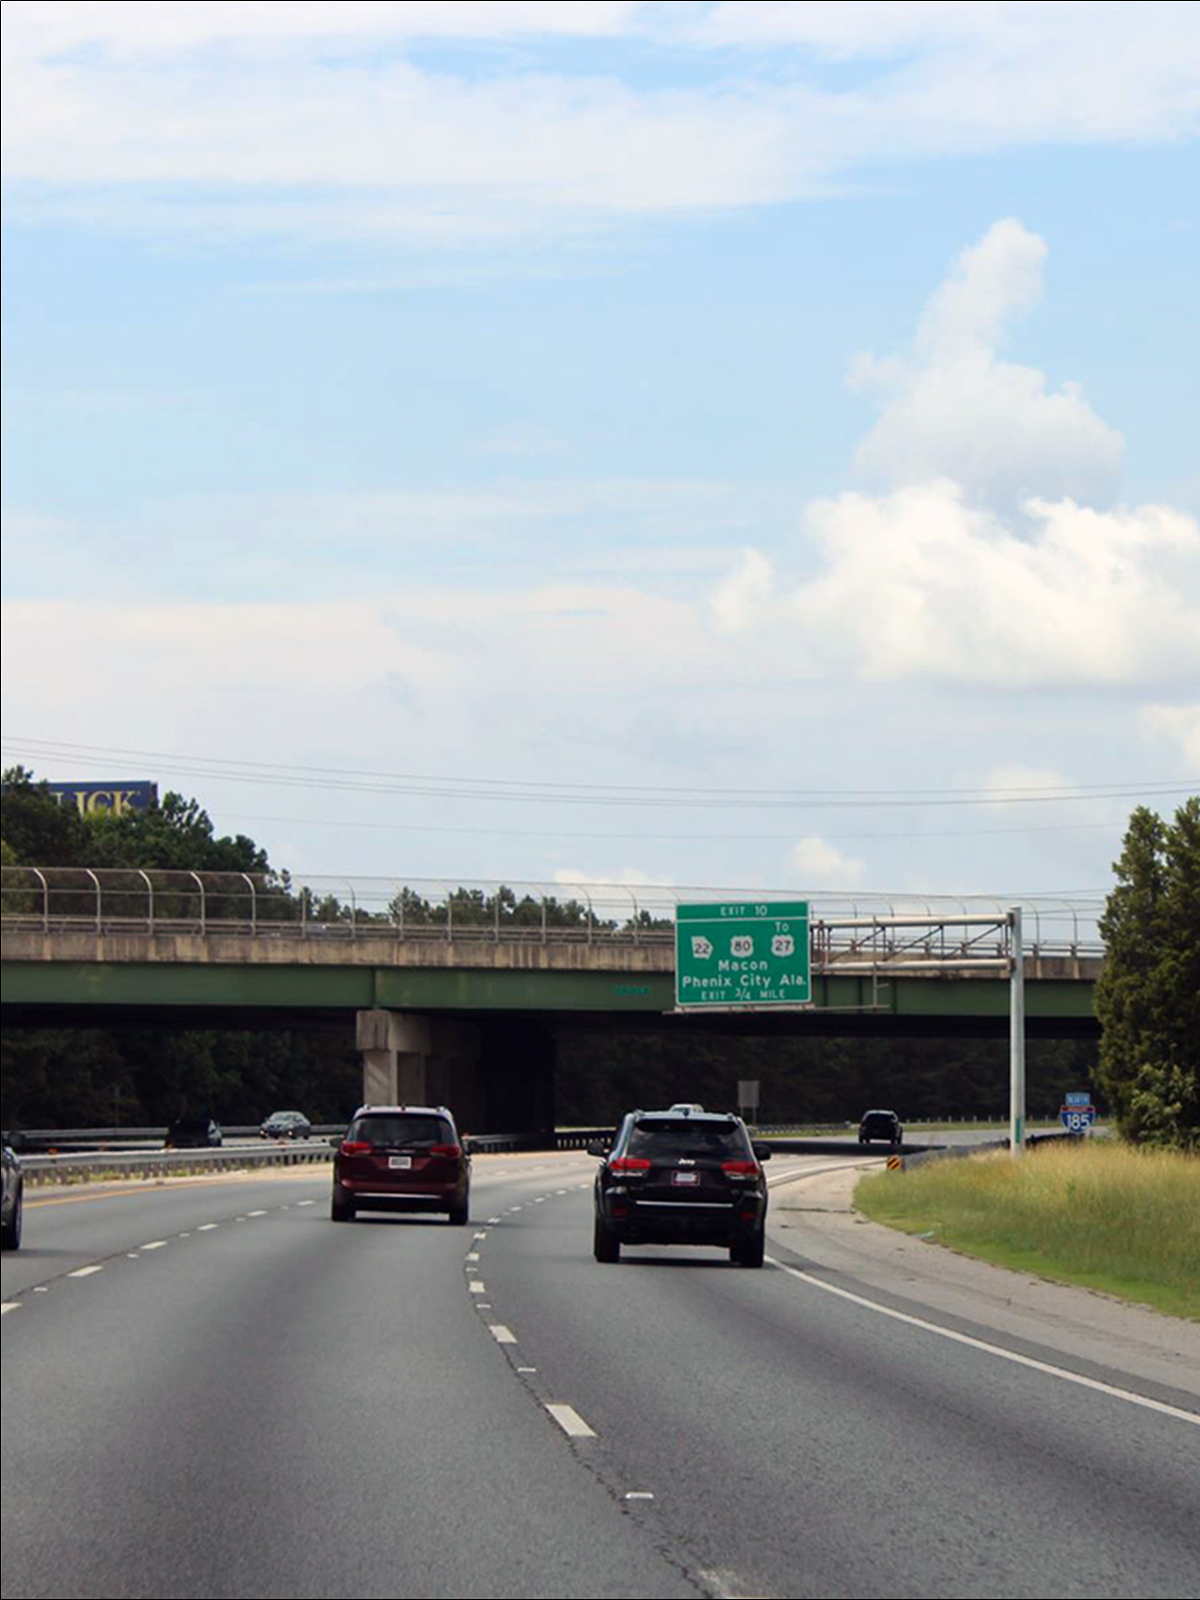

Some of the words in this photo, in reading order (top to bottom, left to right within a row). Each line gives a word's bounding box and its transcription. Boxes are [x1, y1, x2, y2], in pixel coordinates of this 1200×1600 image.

[720, 906, 745, 916] EXIT
[755, 905, 768, 916] 10
[694, 942, 710, 954] 22
[733, 940, 751, 952] 80
[774, 940, 792, 951] 27
[718, 960, 769, 972] Macon
[682, 975, 732, 988] Phenix
[740, 974, 771, 989] City
[701, 991, 726, 1000] EXIT
[760, 989, 785, 999] MILE
[1066, 1114, 1091, 1129] 185
